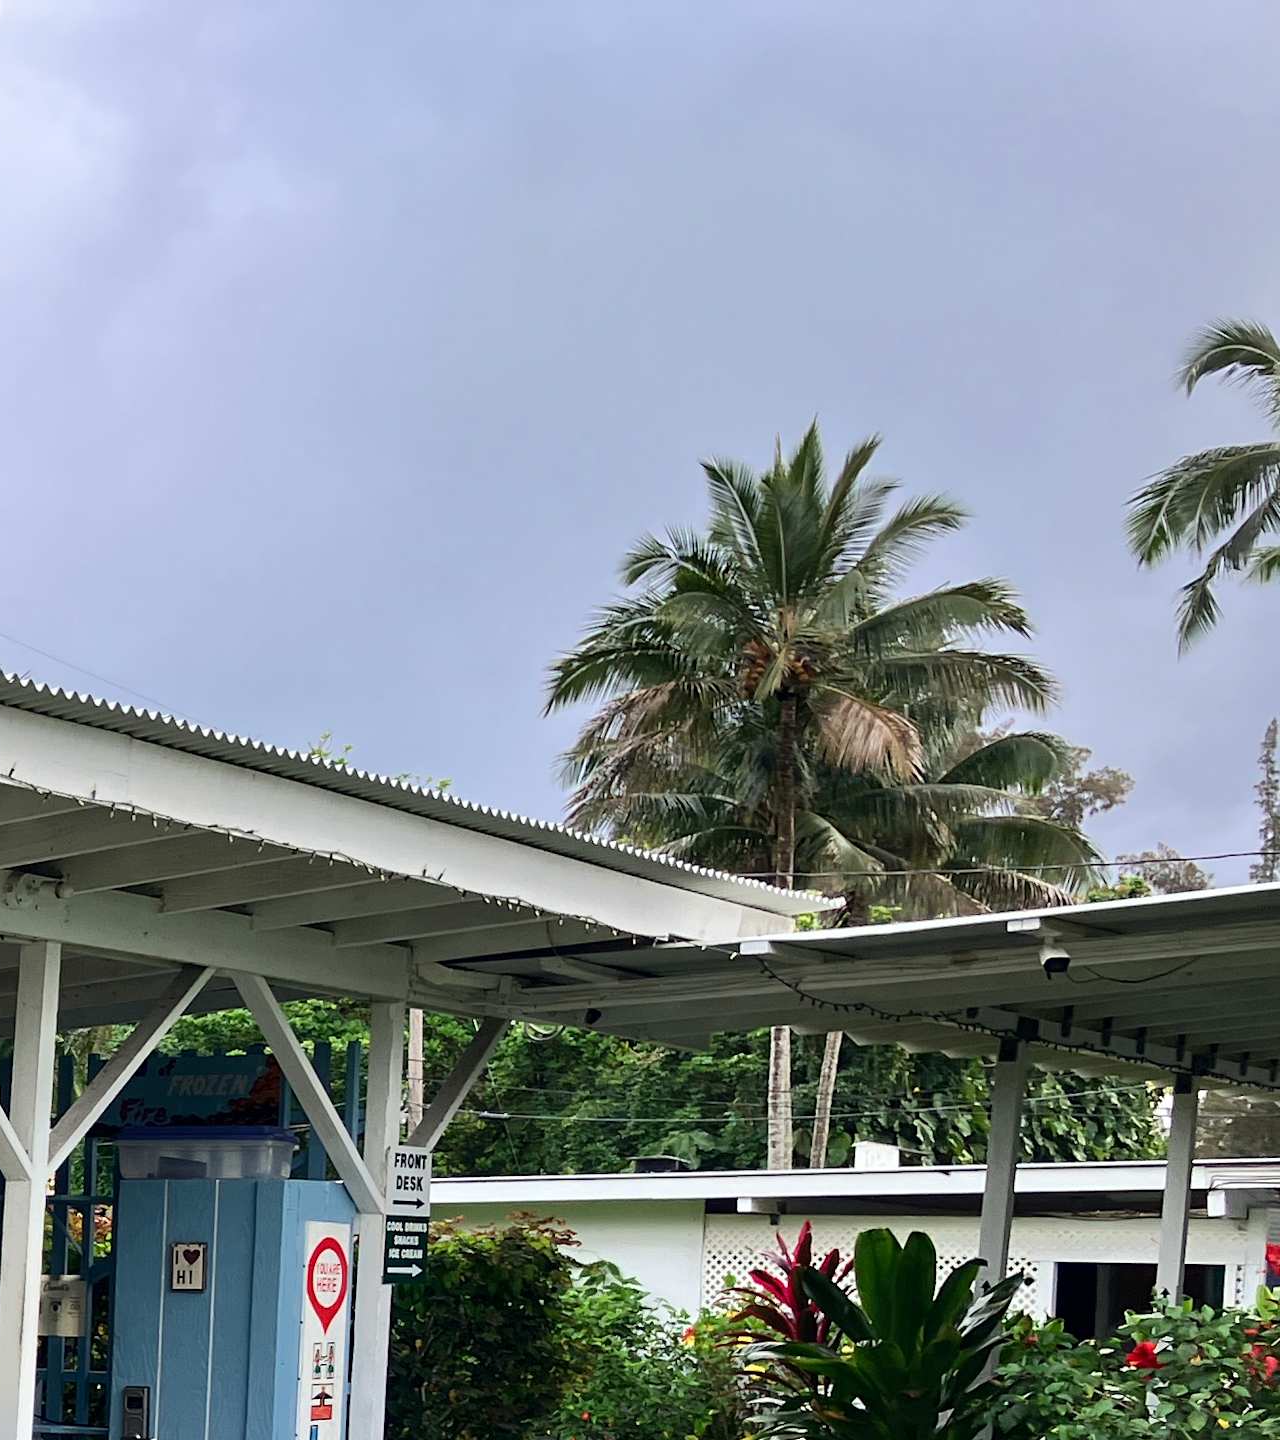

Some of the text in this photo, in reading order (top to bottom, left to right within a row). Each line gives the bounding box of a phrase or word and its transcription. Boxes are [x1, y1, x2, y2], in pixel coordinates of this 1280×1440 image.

[394, 1152, 428, 1170] FRONT
[396, 1175, 424, 1191] DESK
[386, 1221, 404, 1232] COOL
[388, 1248, 400, 1259] ICE
[177, 1270, 193, 1285] HI
